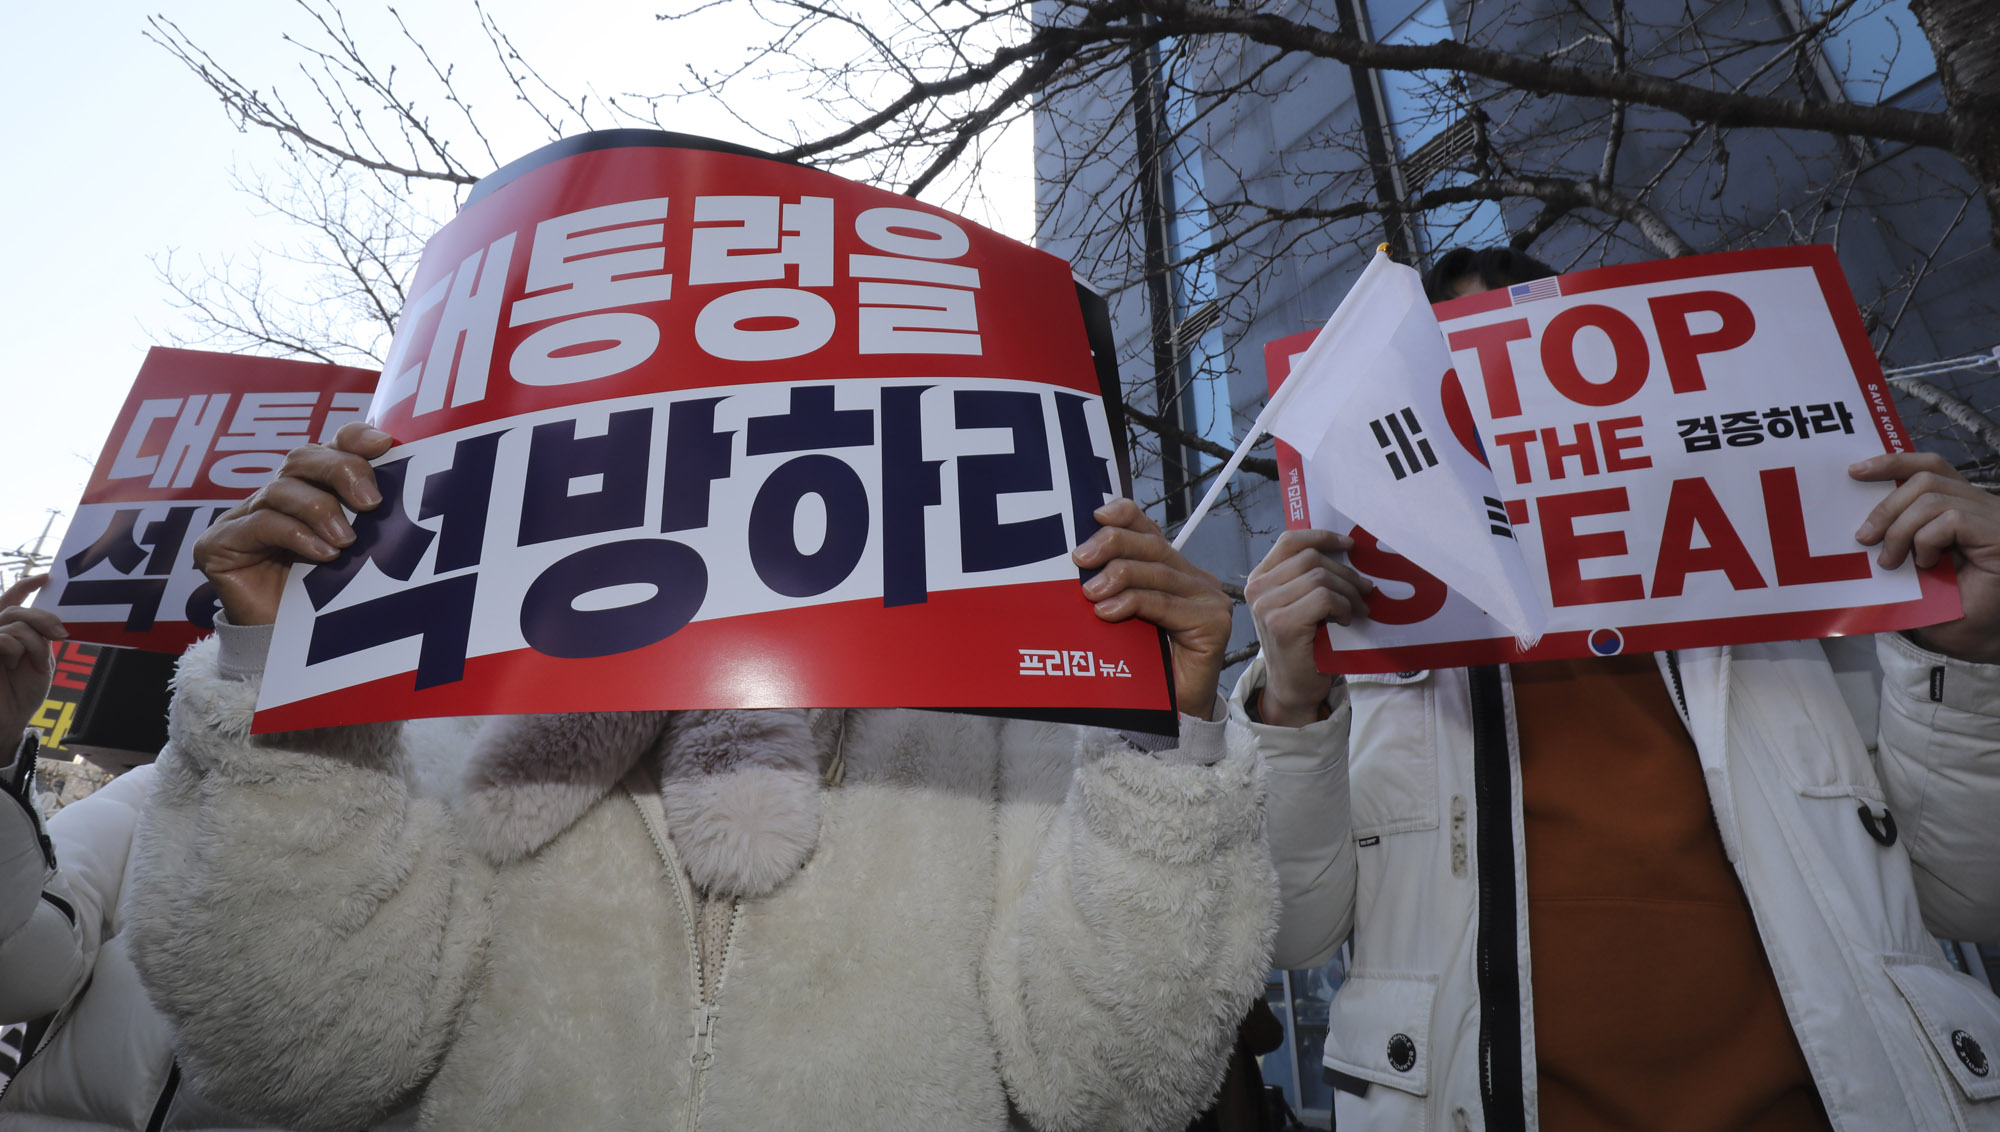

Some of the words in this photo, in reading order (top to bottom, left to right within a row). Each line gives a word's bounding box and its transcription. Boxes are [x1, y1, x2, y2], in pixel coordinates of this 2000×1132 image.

[372, 195, 983, 418] 대통령을
[1448, 290, 1756, 419] TOP
[1494, 415, 1653, 485] THE
[1676, 401, 1854, 453] 검증하라
[1867, 383, 1887, 413] SAVE
[1880, 416, 1904, 453] KOREA
[1287, 484, 1304, 522] 프리진
[302, 385, 1113, 692] 석방하라
[1018, 649, 1096, 676] 프리진
[1099, 659, 1132, 677] 뉴스
